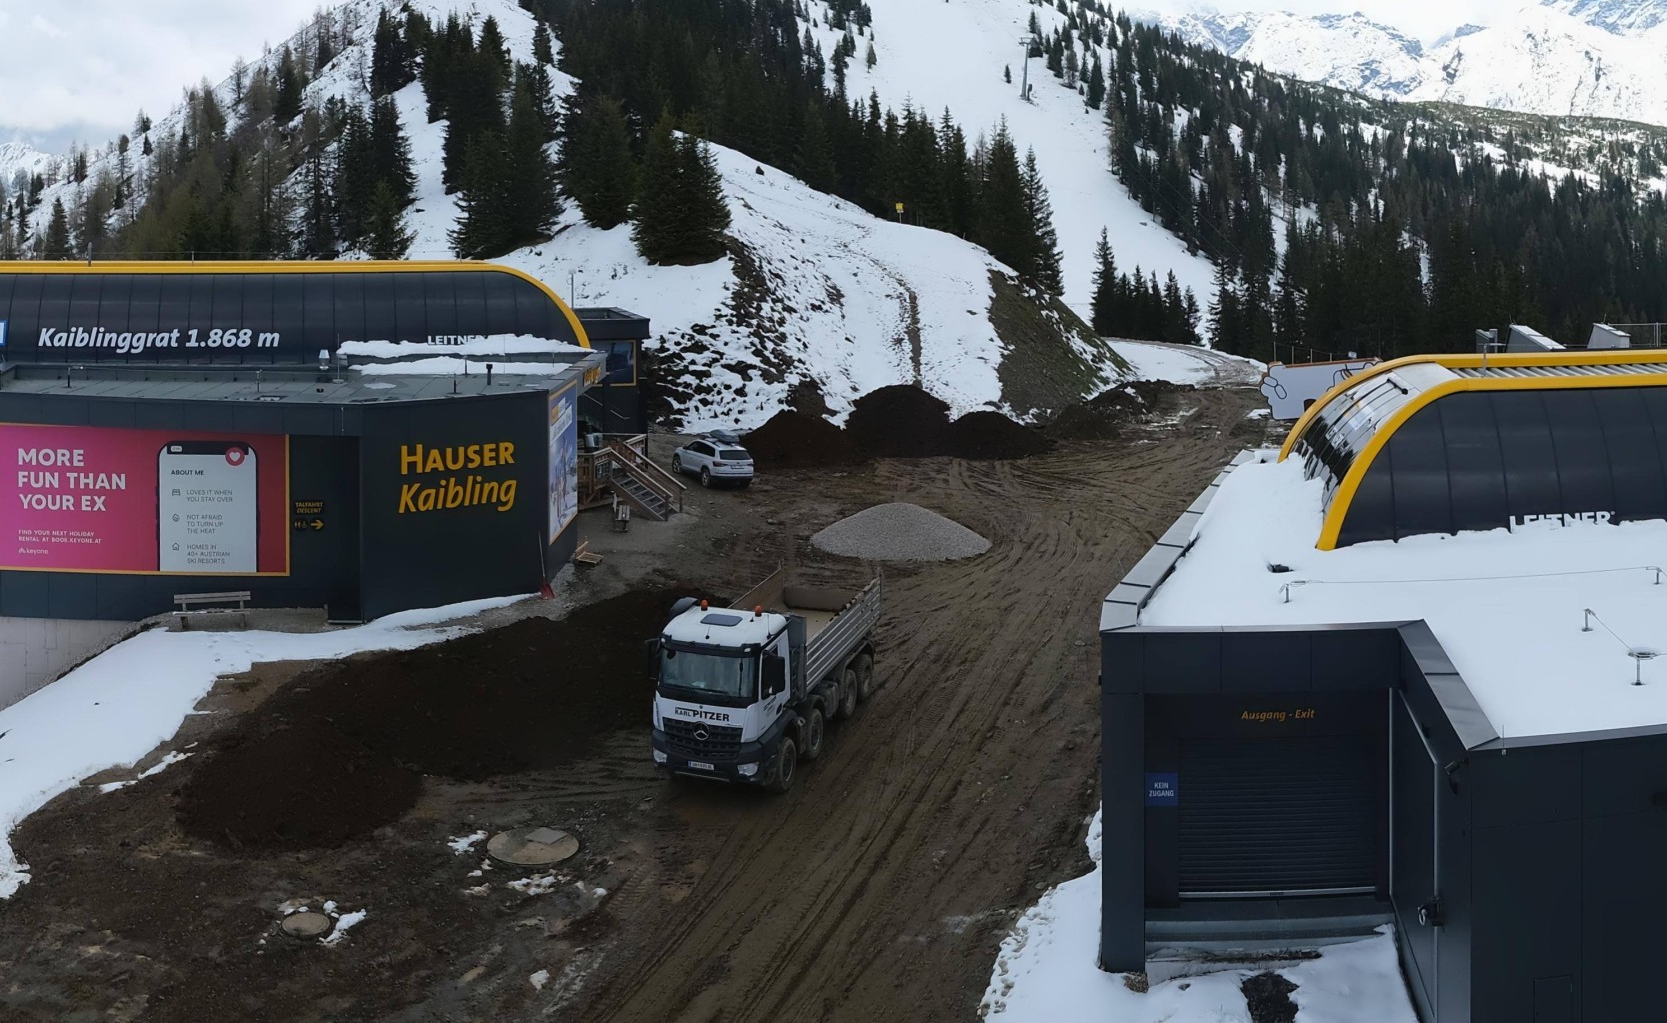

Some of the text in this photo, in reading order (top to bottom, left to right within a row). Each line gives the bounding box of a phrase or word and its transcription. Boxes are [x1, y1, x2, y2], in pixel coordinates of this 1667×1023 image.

[38, 327, 280, 353] Kaiblinggrat 1.868 m
[427, 335, 485, 345] LEITN
[18, 448, 85, 467] MORE
[401, 442, 515, 475] HAUSER
[18, 471, 126, 490] FUN THAN
[19, 494, 106, 511] YOUR EX
[398, 475, 518, 514] Kaibling
[675, 709, 730, 722] KARL PITZER
[1241, 710, 1286, 722] Ausgang
[1295, 709, 1315, 719] Exit
[1149, 789, 1174, 797] ZUGANG
